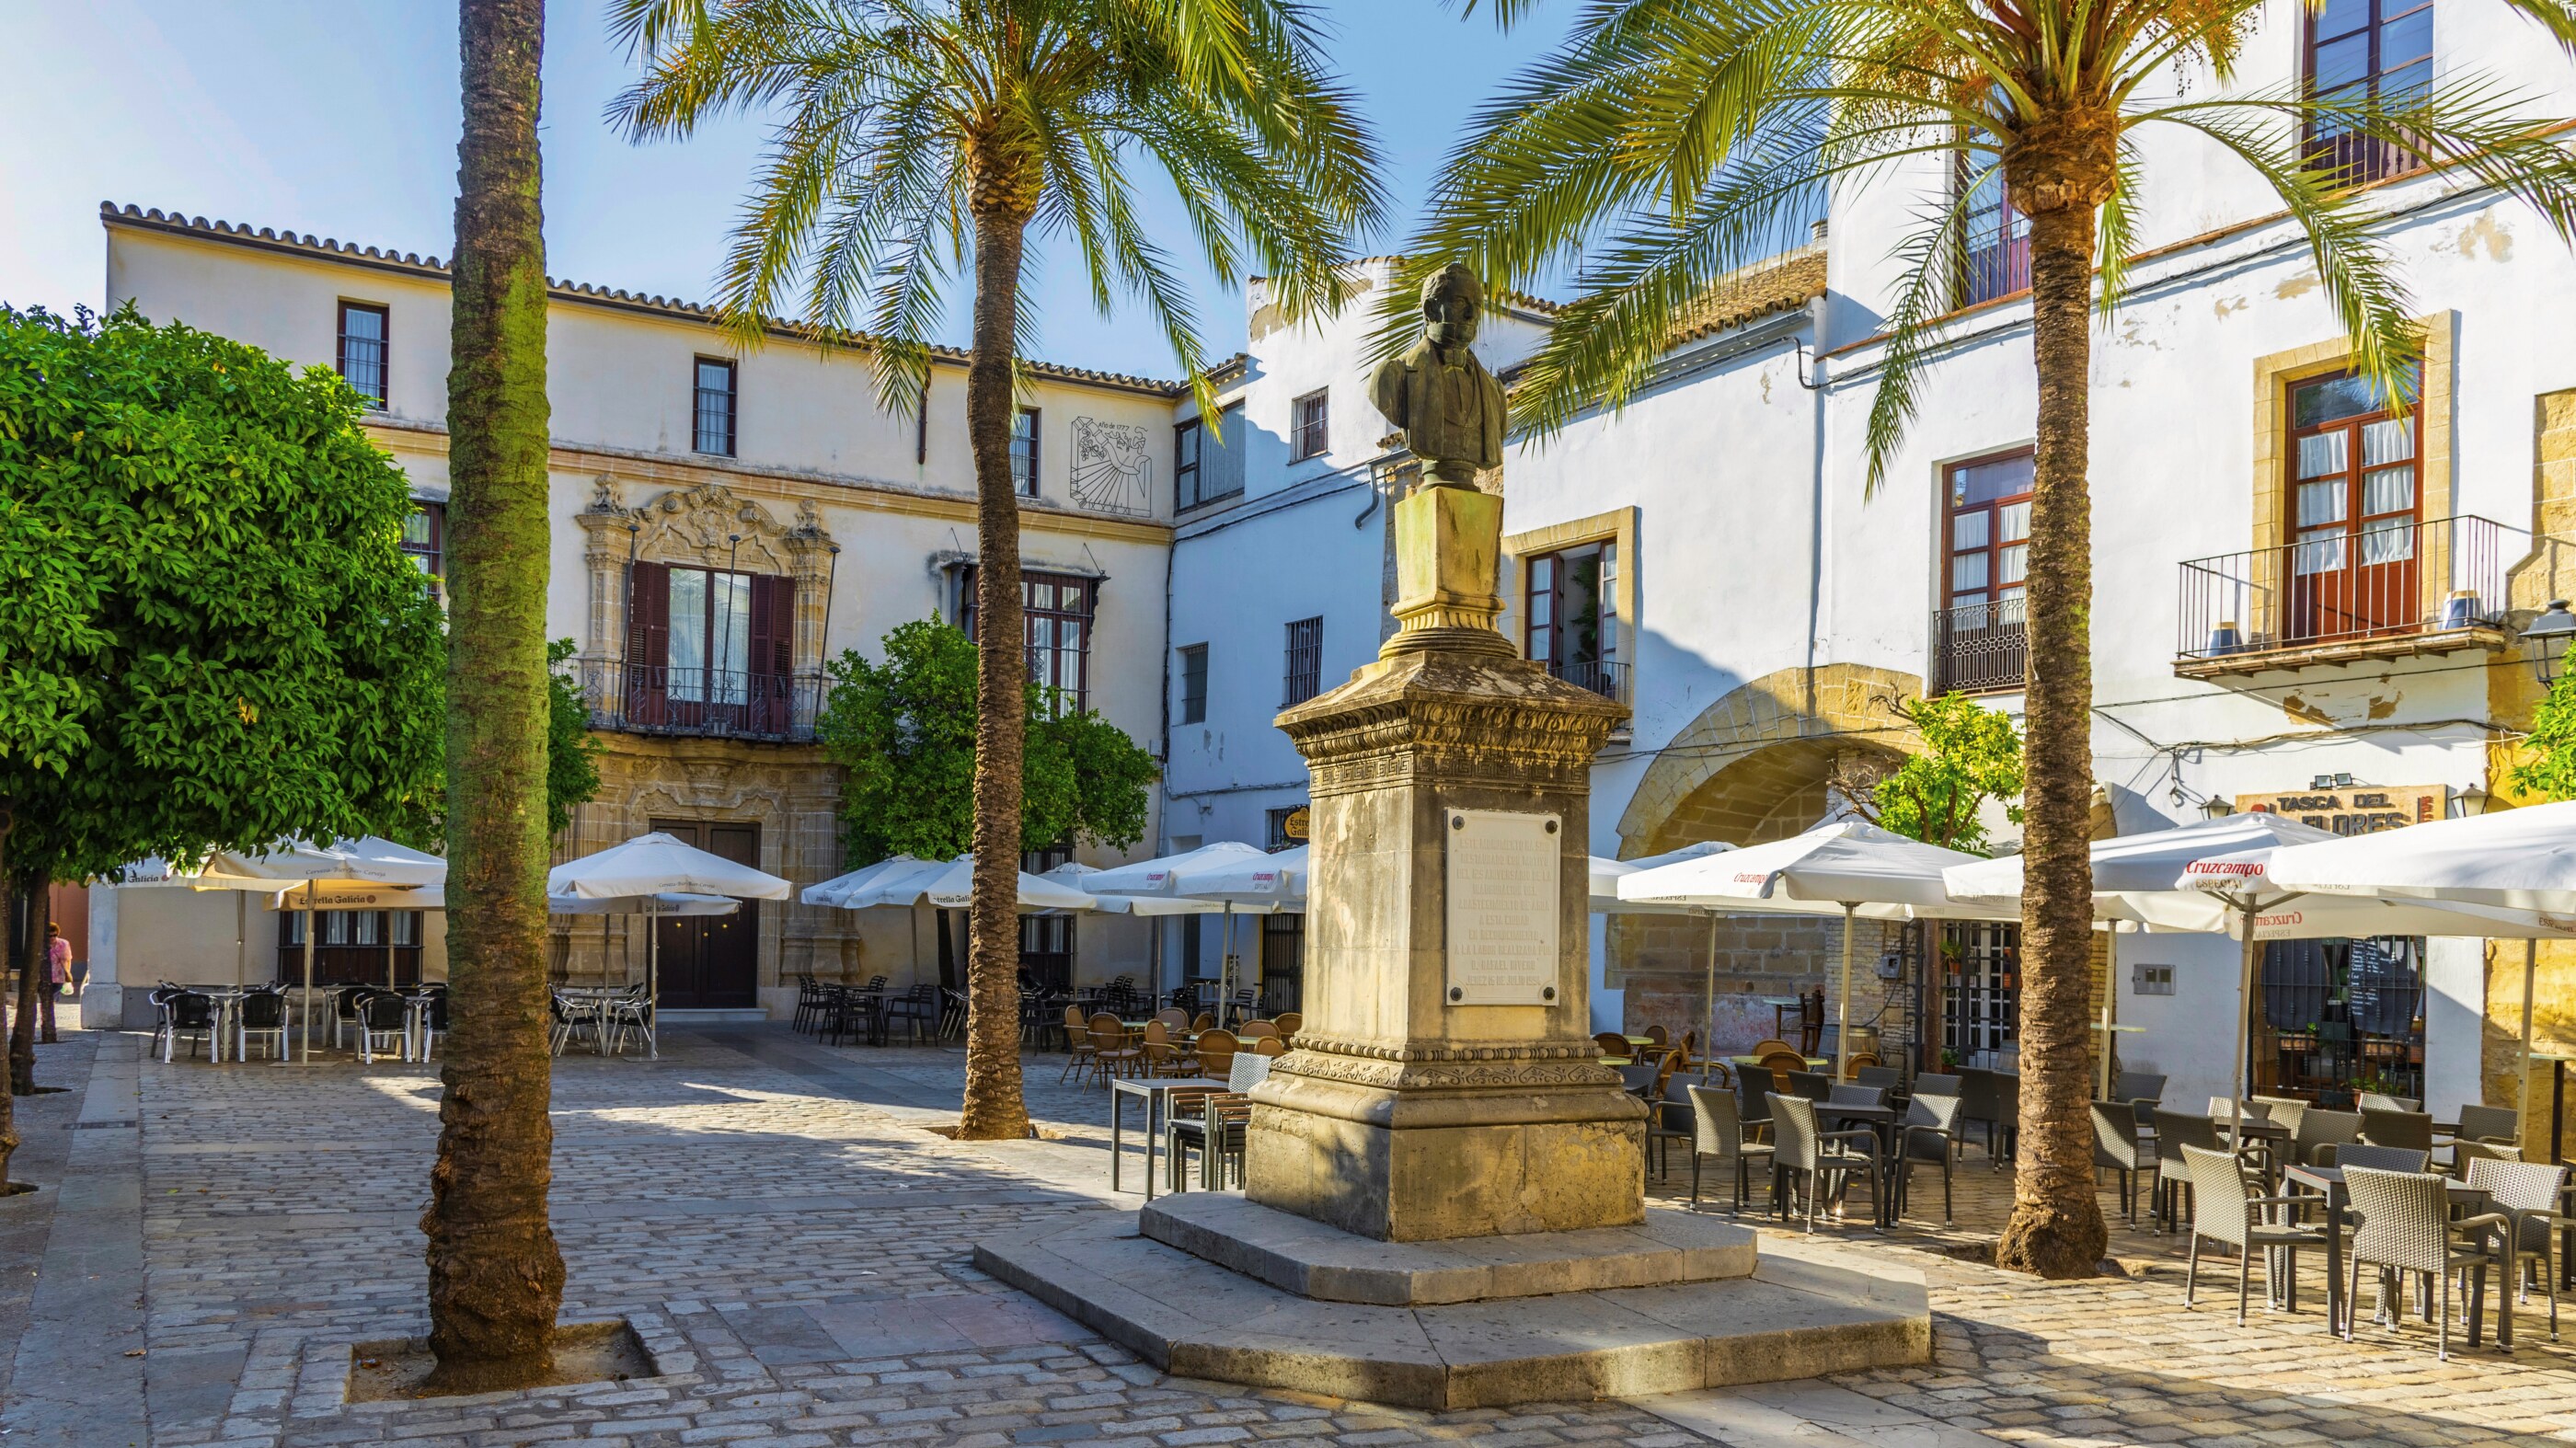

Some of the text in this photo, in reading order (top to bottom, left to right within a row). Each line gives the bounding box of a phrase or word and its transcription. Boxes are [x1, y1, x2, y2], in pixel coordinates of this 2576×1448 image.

[2277, 793, 2393, 811] TASCA DEL
[1459, 838, 1477, 850] ESTE
[2186, 859, 2264, 878] Cruzcampo
[334, 895, 365, 903] Galicia
[1478, 914, 1485, 925] A
[1486, 914, 1503, 925] ESTA
[1461, 944, 1472, 956] LA
[1473, 944, 1497, 956] LABOR
[1498, 944, 1537, 956] REALIZADA
[1481, 960, 1509, 971] RAFAEL
[1510, 960, 1535, 971] RIVERO
[1466, 975, 1488, 986] JEREZ
[1496, 975, 1506, 986] DE
[1506, 975, 1525, 986] JULIO
